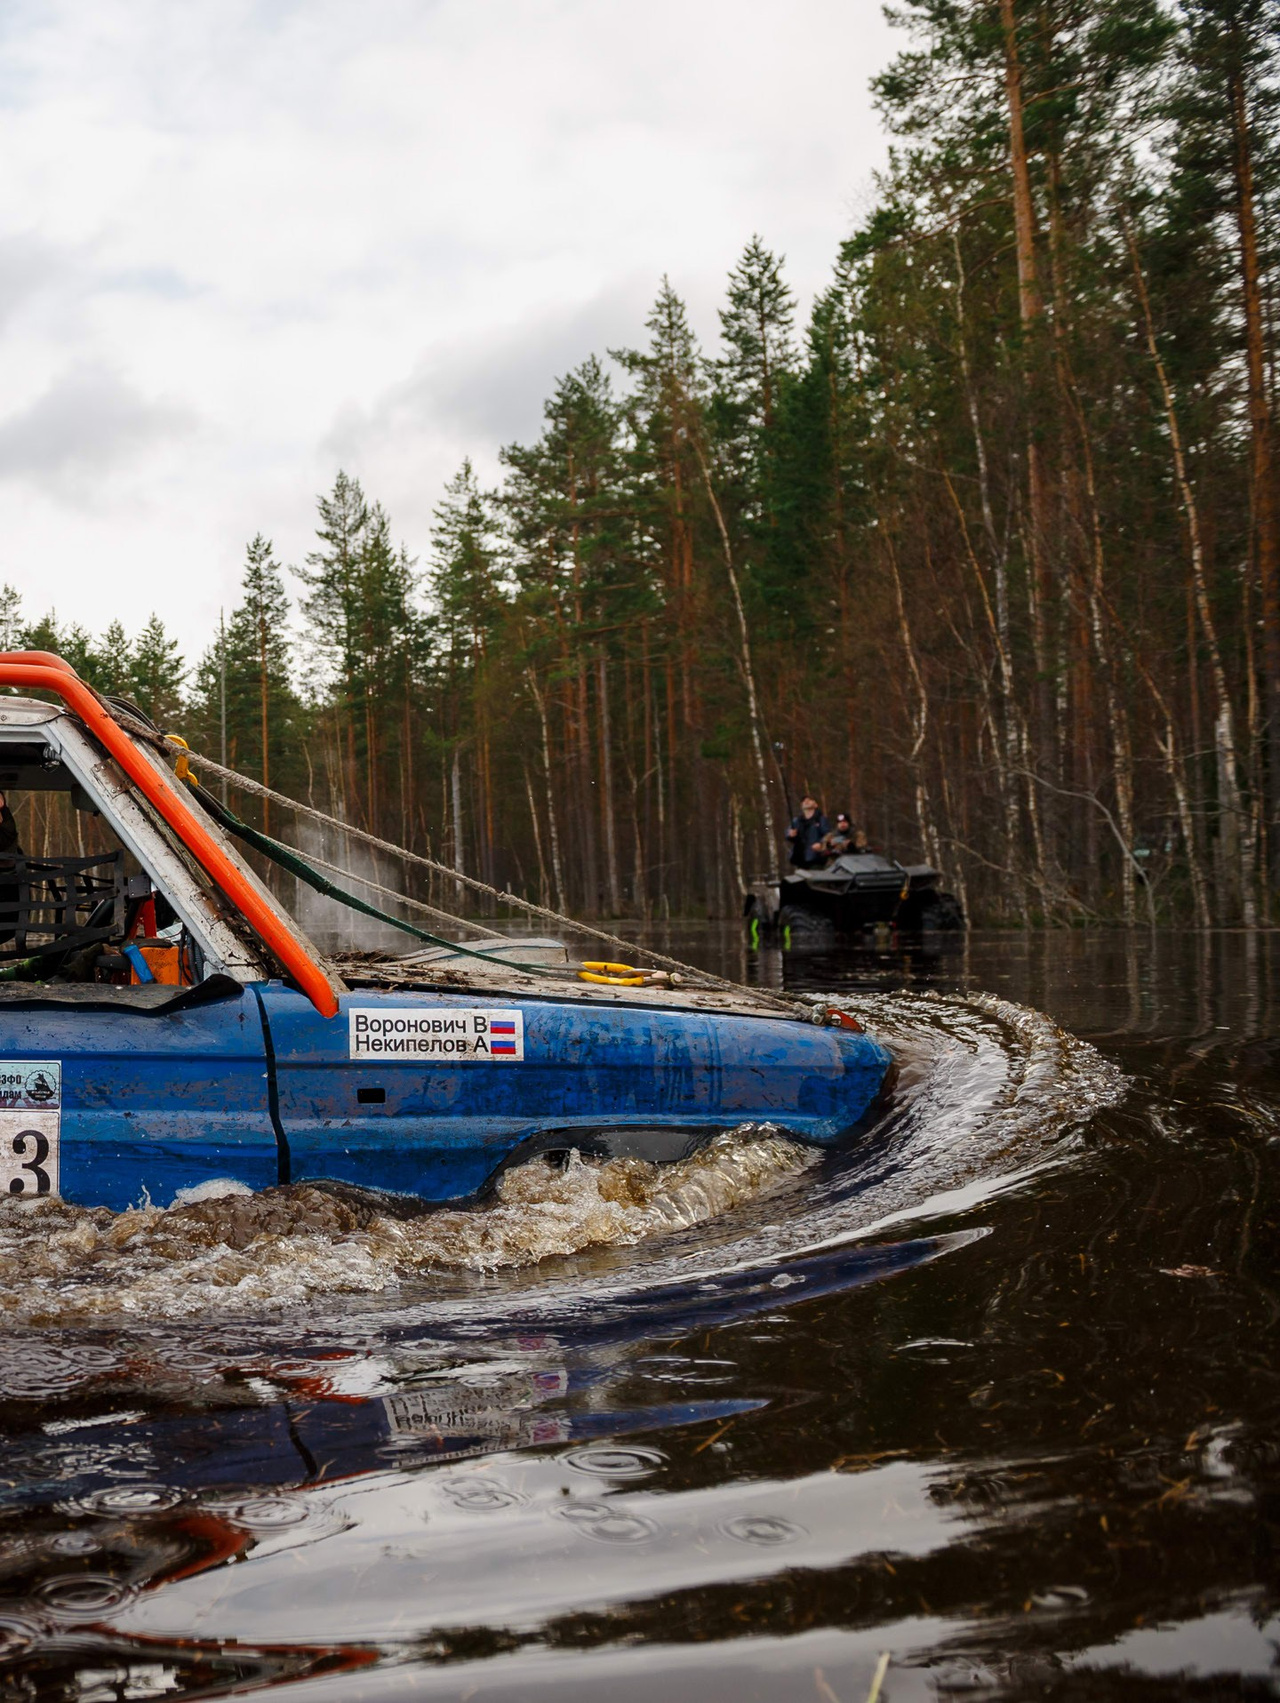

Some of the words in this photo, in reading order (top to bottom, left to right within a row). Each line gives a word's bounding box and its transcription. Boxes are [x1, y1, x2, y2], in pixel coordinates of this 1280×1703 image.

[355, 1014, 467, 1036] Воронович
[474, 1016, 487, 1032] В
[355, 1035, 467, 1052] Некипелов
[473, 1036, 489, 1052] А
